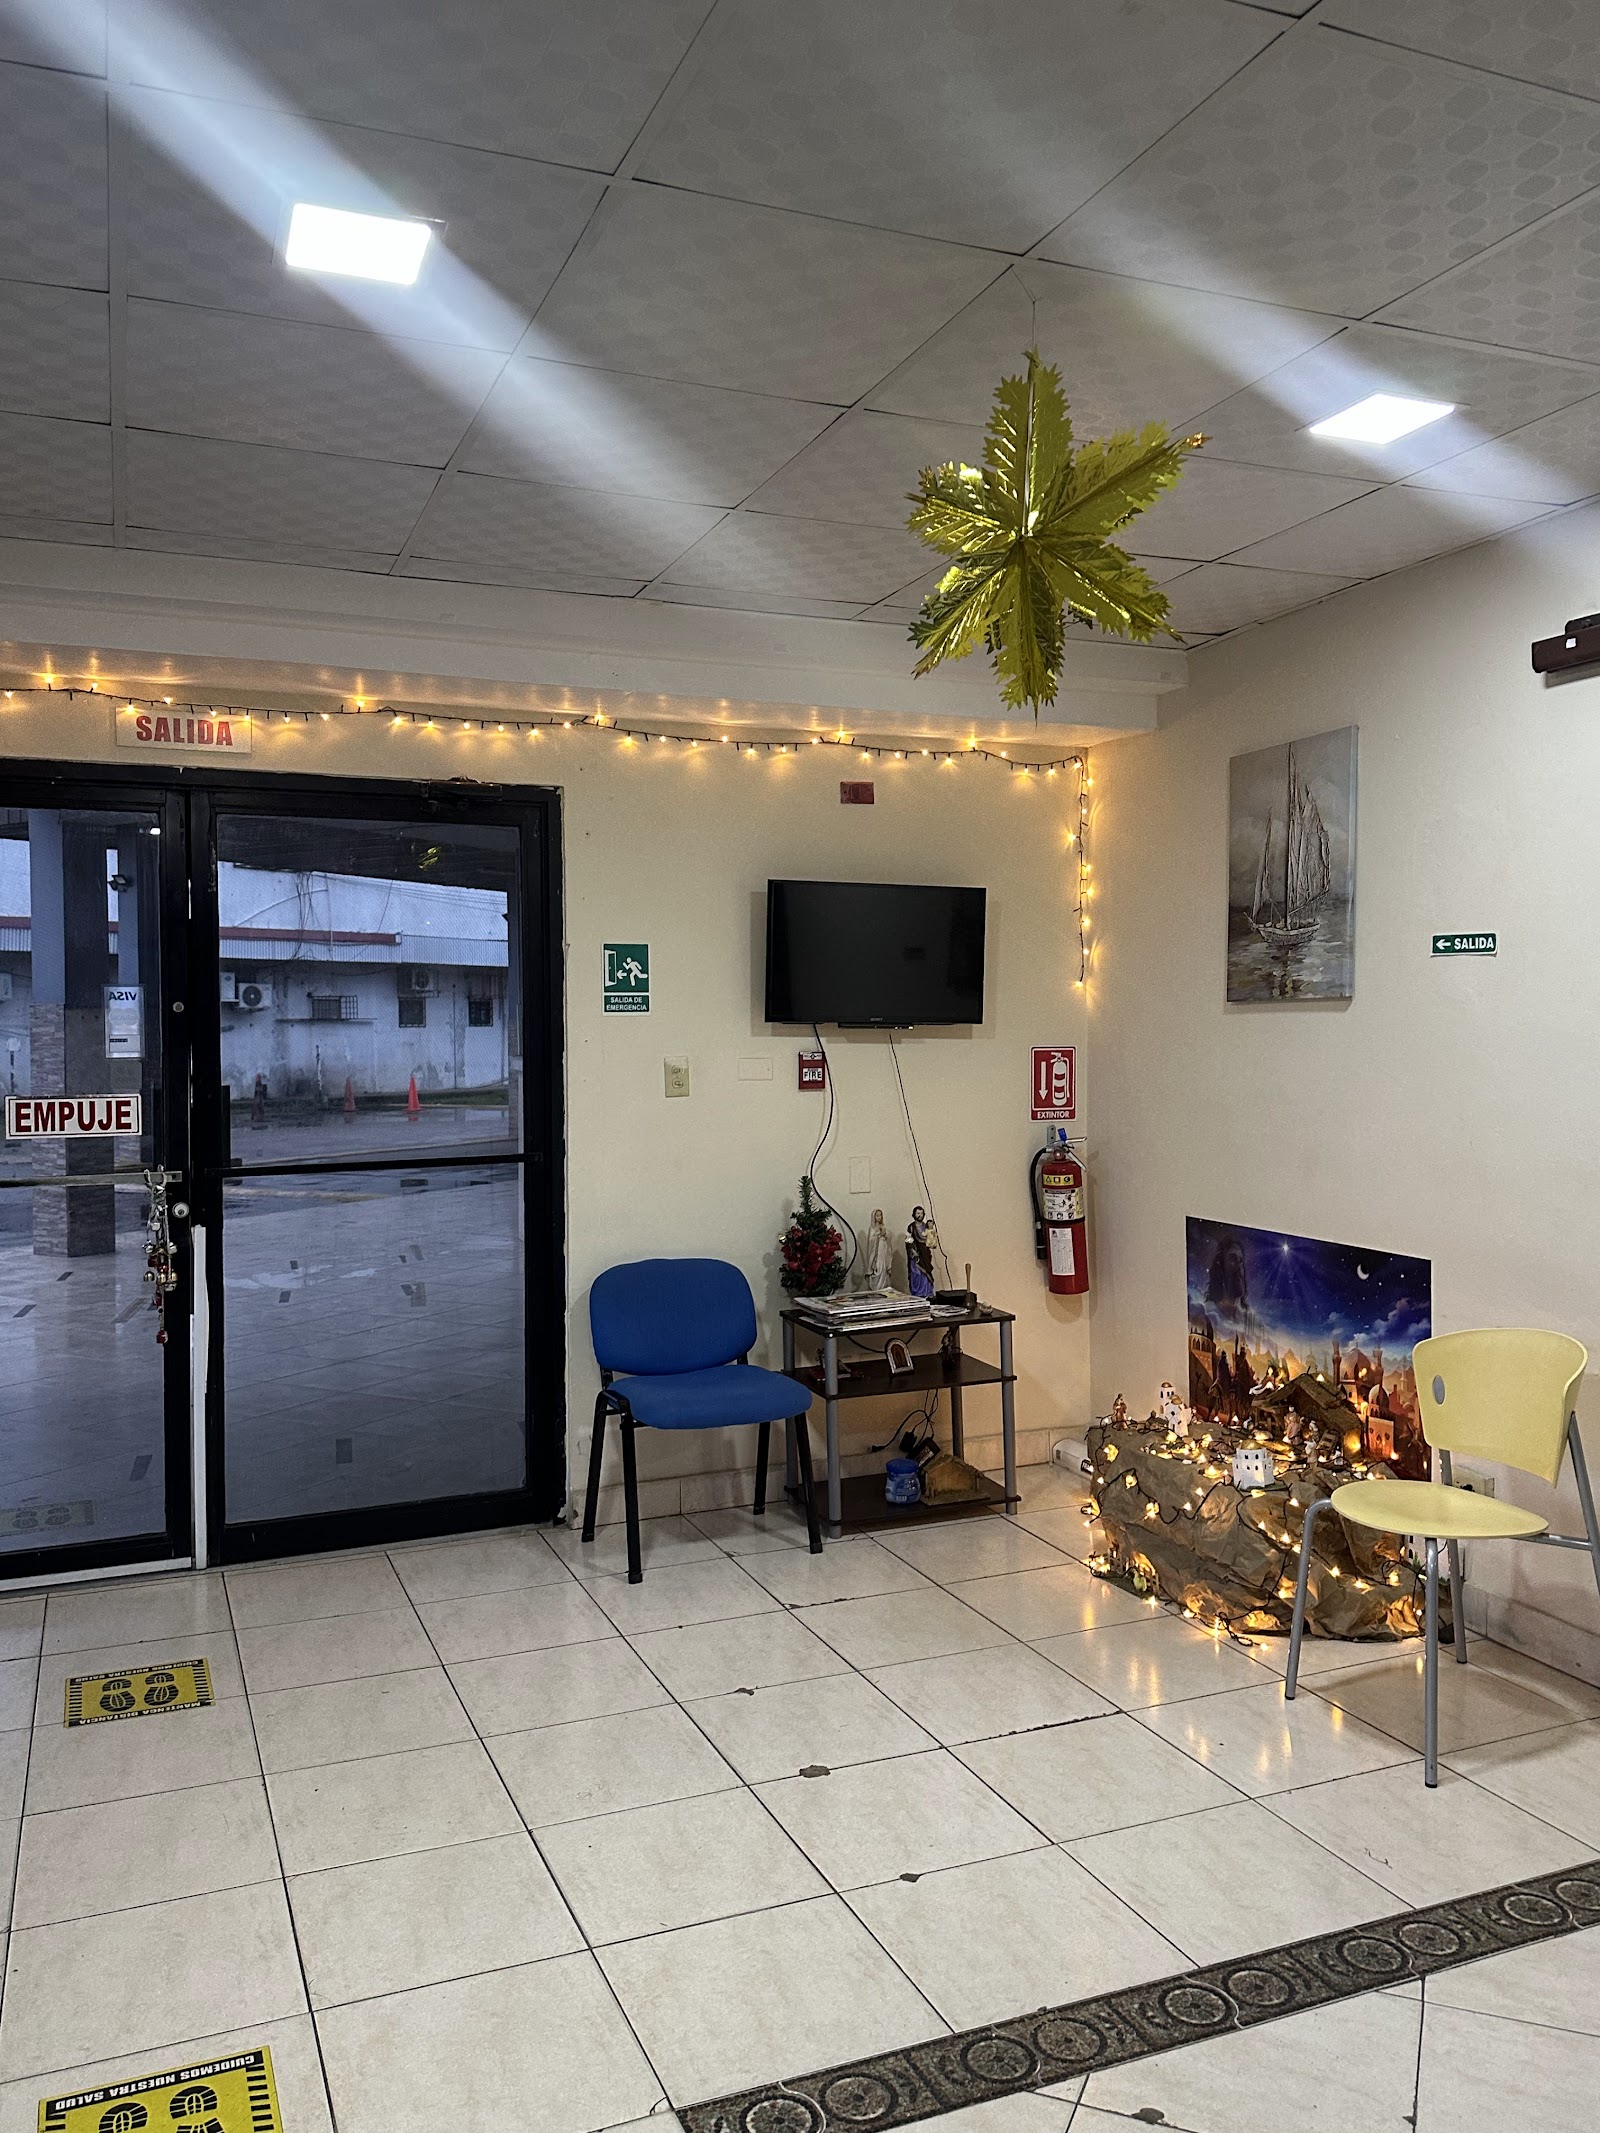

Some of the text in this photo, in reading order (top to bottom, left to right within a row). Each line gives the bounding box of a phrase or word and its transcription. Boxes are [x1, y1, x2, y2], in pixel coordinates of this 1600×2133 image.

[135, 715, 233, 746] SALIDA
[1454, 937, 1494, 950] SALIDA
[610, 996, 643, 1004] SALIDA DE
[803, 1070, 822, 1079] FIRE
[15, 1100, 132, 1133] EMPUJE
[1037, 1111, 1070, 1119] EXTINTOR
[79, 1710, 139, 1725] DISTANCIA
[55, 2054, 255, 2111] CUIDEMOS NUESTRA SALUD
